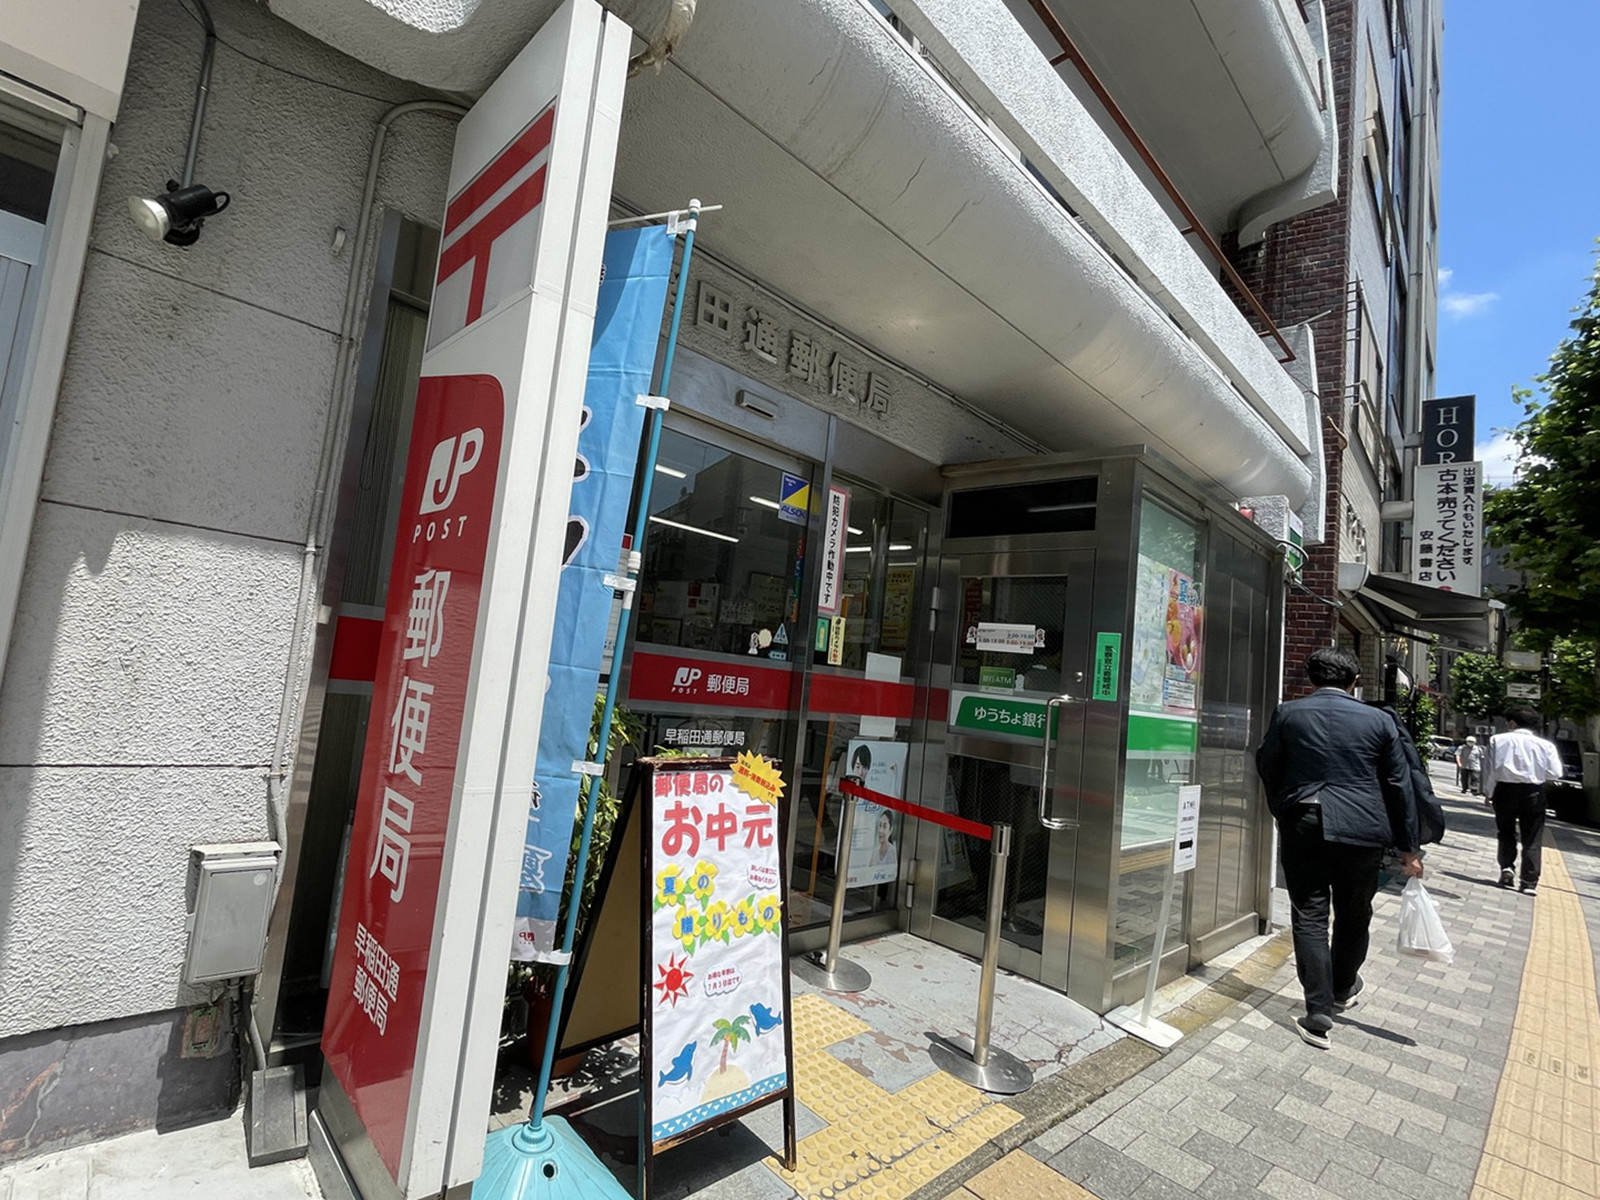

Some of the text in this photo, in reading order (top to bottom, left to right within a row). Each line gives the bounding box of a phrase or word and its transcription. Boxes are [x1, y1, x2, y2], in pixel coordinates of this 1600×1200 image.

[412, 516, 467, 544] POST
[1436, 468, 1460, 582] 古本売ってください
[824, 494, 841, 604] 防犯カメラ作動中です
[1418, 530, 1434, 582] 安藤書店
[671, 687, 697, 695] POST
[706, 674, 750, 696] 郵便局
[974, 706, 1047, 728] ゆうちょ銀行
[369, 569, 452, 903] 郵便局
[664, 728, 746, 746] 早稲田通郵便局
[654, 773, 724, 798] 郵便局の
[662, 801, 774, 858] お中元
[663, 874, 710, 895] 夏の
[681, 906, 775, 934] 贈りもの
[355, 921, 400, 1003] 早稲田通
[353, 964, 389, 1036] 郵便局
